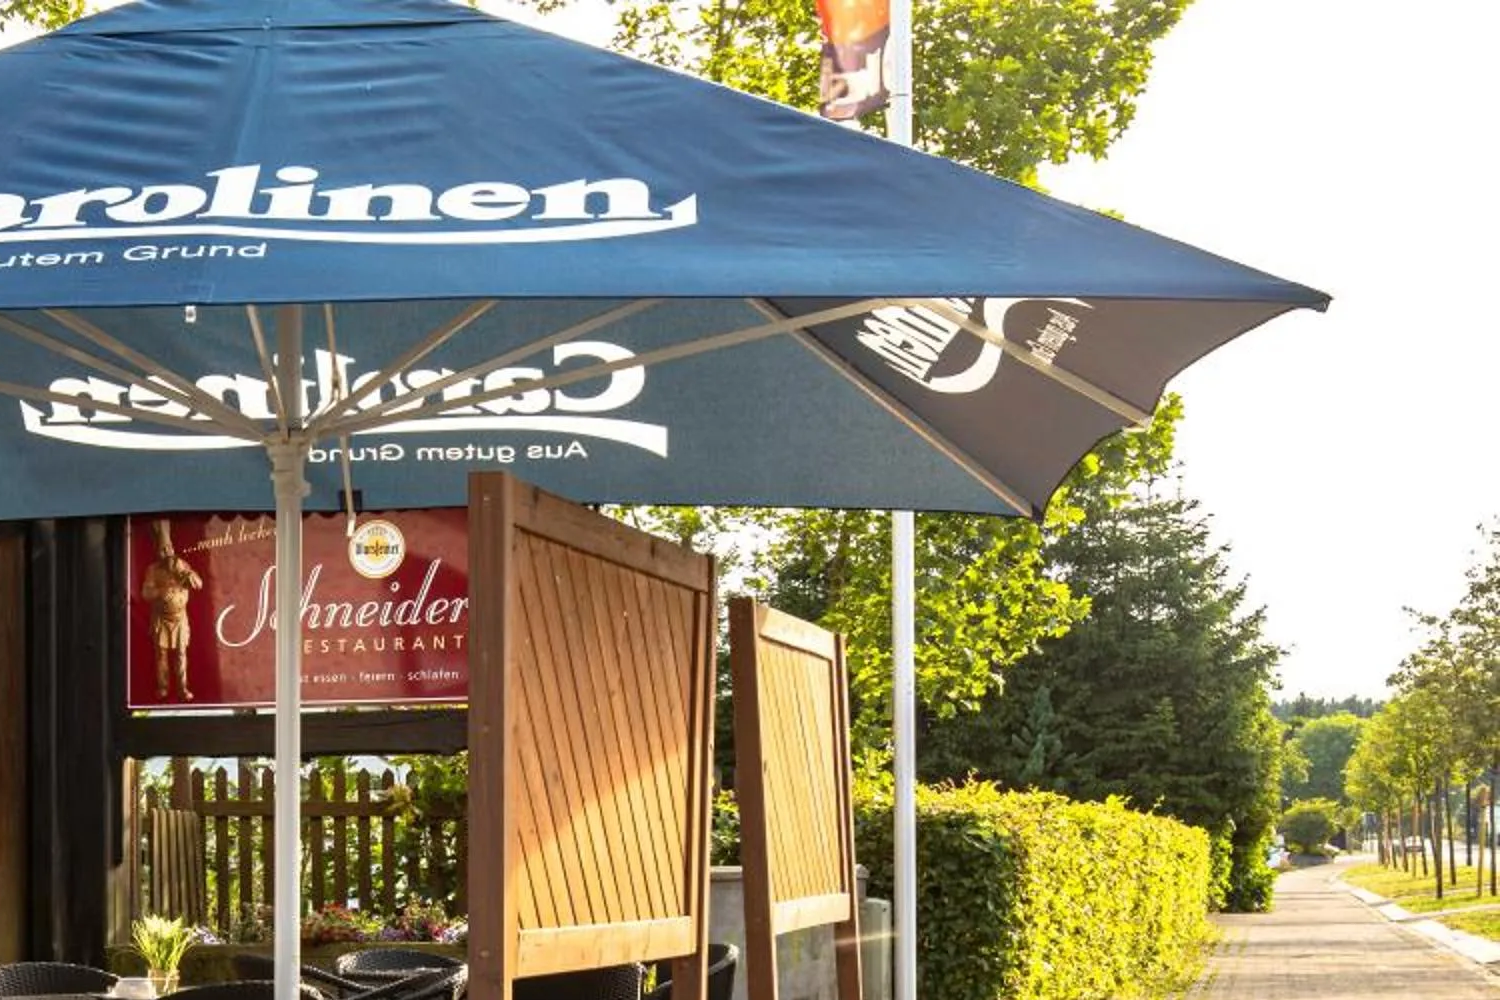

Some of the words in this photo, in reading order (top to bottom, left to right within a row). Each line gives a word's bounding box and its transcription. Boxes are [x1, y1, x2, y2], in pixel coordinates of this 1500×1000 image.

[123, 242, 268, 261] Grund
[303, 635, 465, 654] ESTAURANT
[313, 671, 347, 683] essen
[407, 668, 460, 682] schlafen
